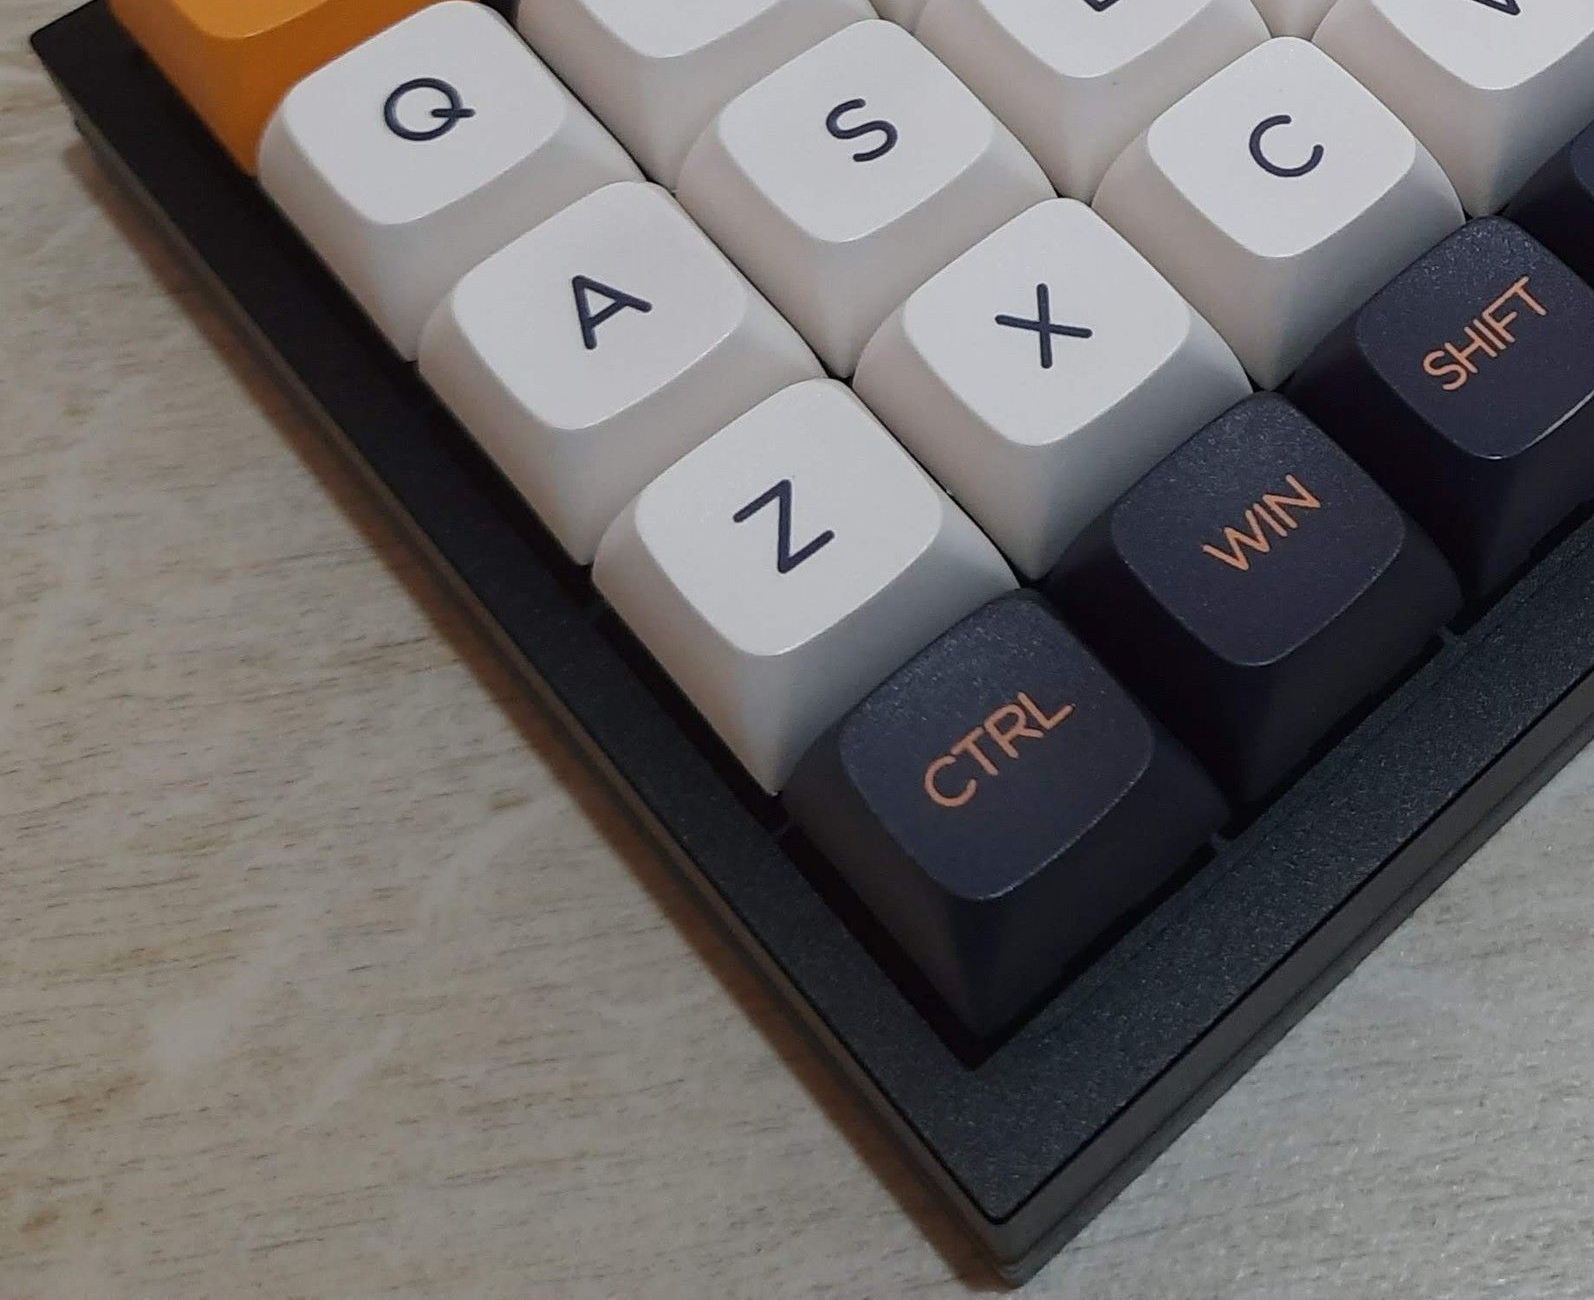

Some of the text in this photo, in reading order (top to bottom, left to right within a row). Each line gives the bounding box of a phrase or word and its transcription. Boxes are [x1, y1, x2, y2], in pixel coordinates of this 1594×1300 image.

[382, 77, 476, 143] Q
[824, 98, 898, 163] S
[1248, 114, 1325, 179] C
[570, 274, 653, 351] A
[994, 282, 1093, 370] X
[1422, 275, 1547, 392] SHIFT
[732, 479, 835, 575] Z
[1202, 474, 1321, 571] WIN
[924, 691, 1074, 808] CTRL
